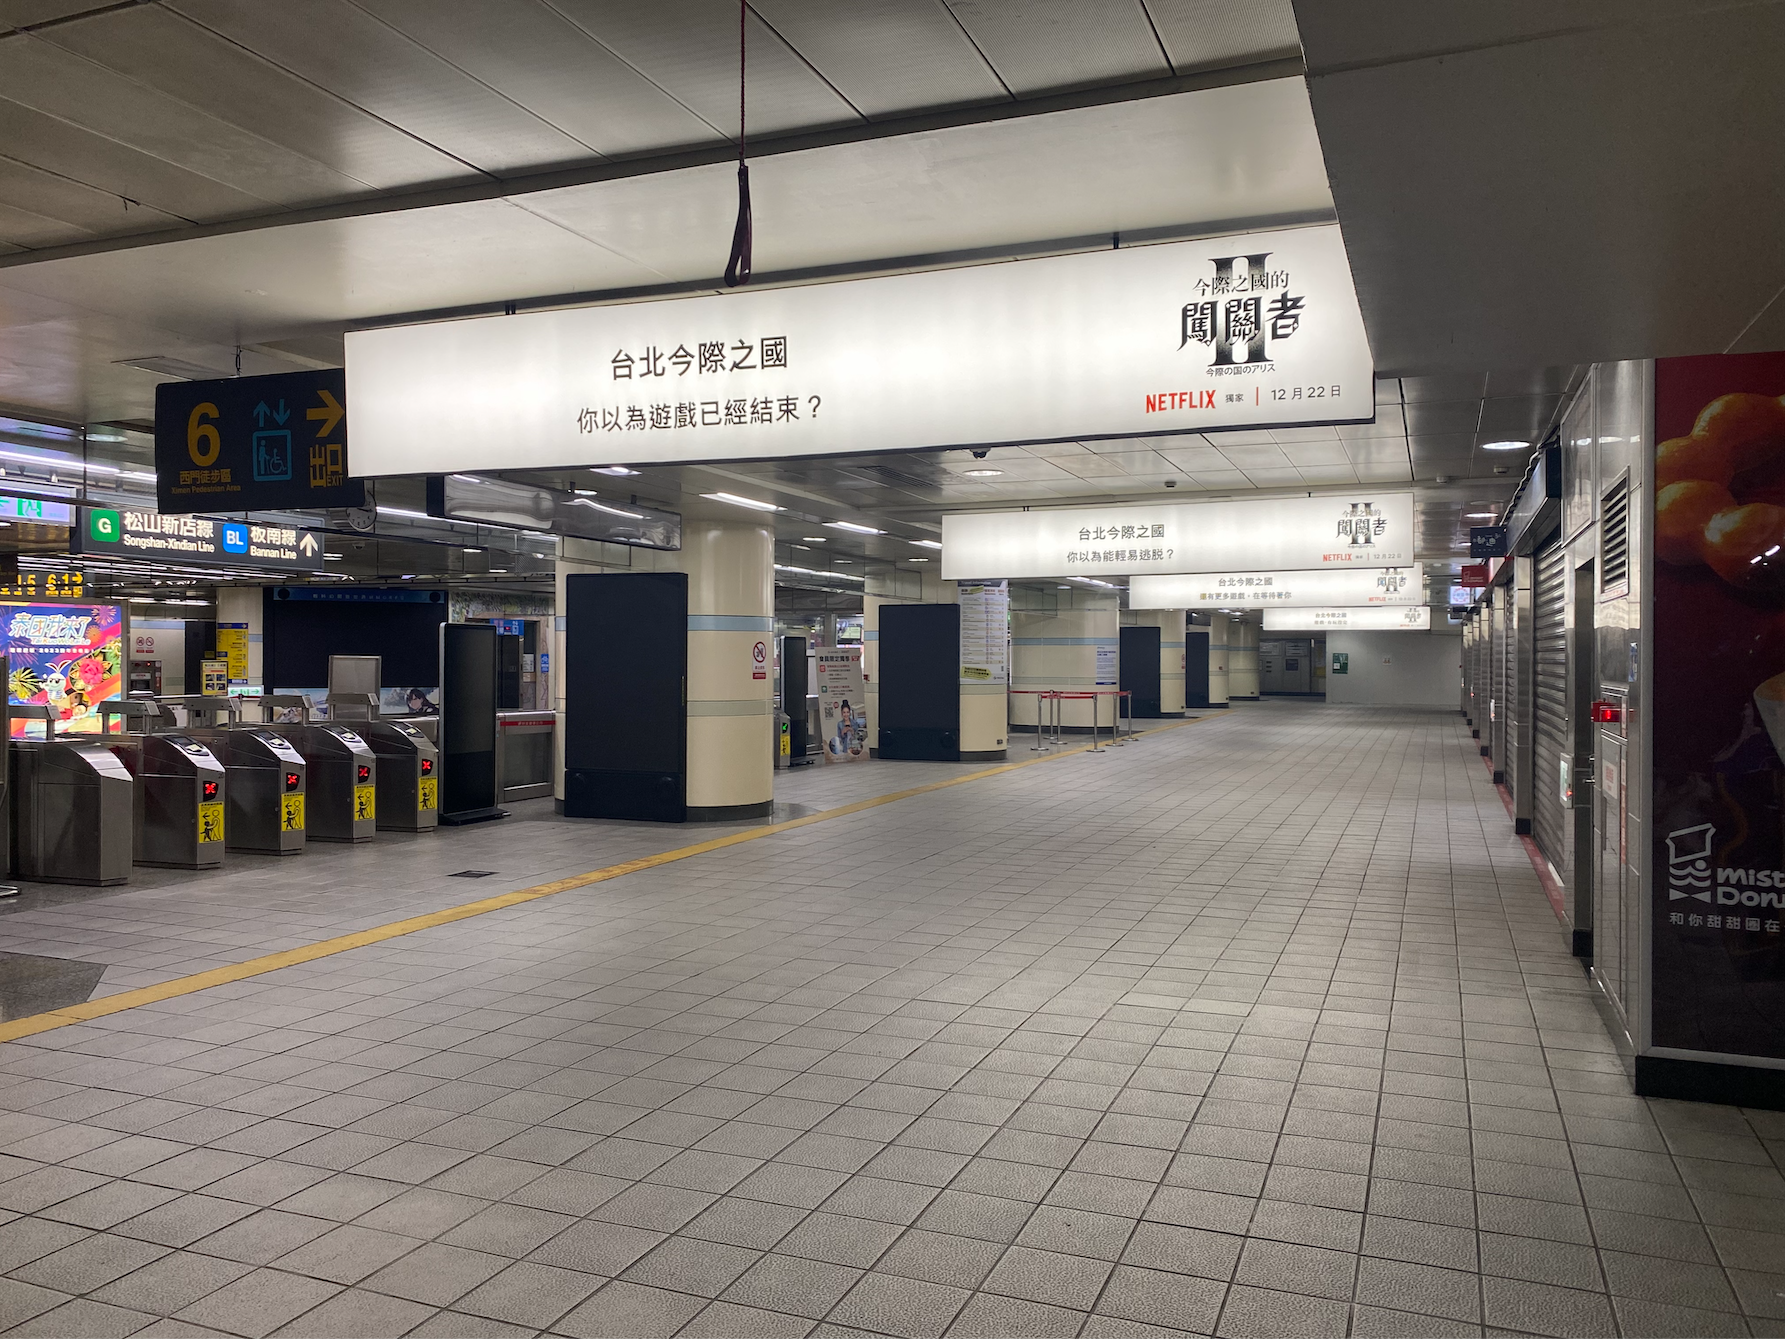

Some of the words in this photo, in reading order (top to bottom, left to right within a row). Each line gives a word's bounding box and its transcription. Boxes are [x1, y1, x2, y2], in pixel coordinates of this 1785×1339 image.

[1192, 269, 1290, 297] 今際之國的
[1176, 289, 1306, 351] 闖關者
[610, 335, 788, 381] 台北今際之國
[1205, 363, 1276, 377] 今際の国のアリス
[1145, 389, 1217, 414] NETFLIX
[1225, 393, 1244, 403] 獨家
[576, 394, 822, 435] 你以為遊戲已經結束？
[187, 401, 221, 467] 6
[310, 443, 343, 489] 出口
[179, 468, 232, 486] 西門徒步區
[326, 474, 344, 487] EXIT
[171, 486, 191, 495] Ximen
[191, 484, 225, 494] Pedestrian
[226, 484, 241, 492] Area
[97, 517, 112, 534] G
[123, 511, 214, 538] 松山新店線
[1078, 524, 1165, 541] 台北今際之國
[123, 533, 198, 552] Songshan-Xindian
[199, 541, 215, 554] Line
[226, 530, 244, 546] BL
[250, 526, 297, 547] 板南線
[250, 545, 279, 559] Bannan
[280, 547, 297, 560] Line
[1322, 553, 1352, 562] NETFLIX
[1218, 577, 1273, 587] 台北今際之國
[8, 613, 92, 639] 泰國我來了
